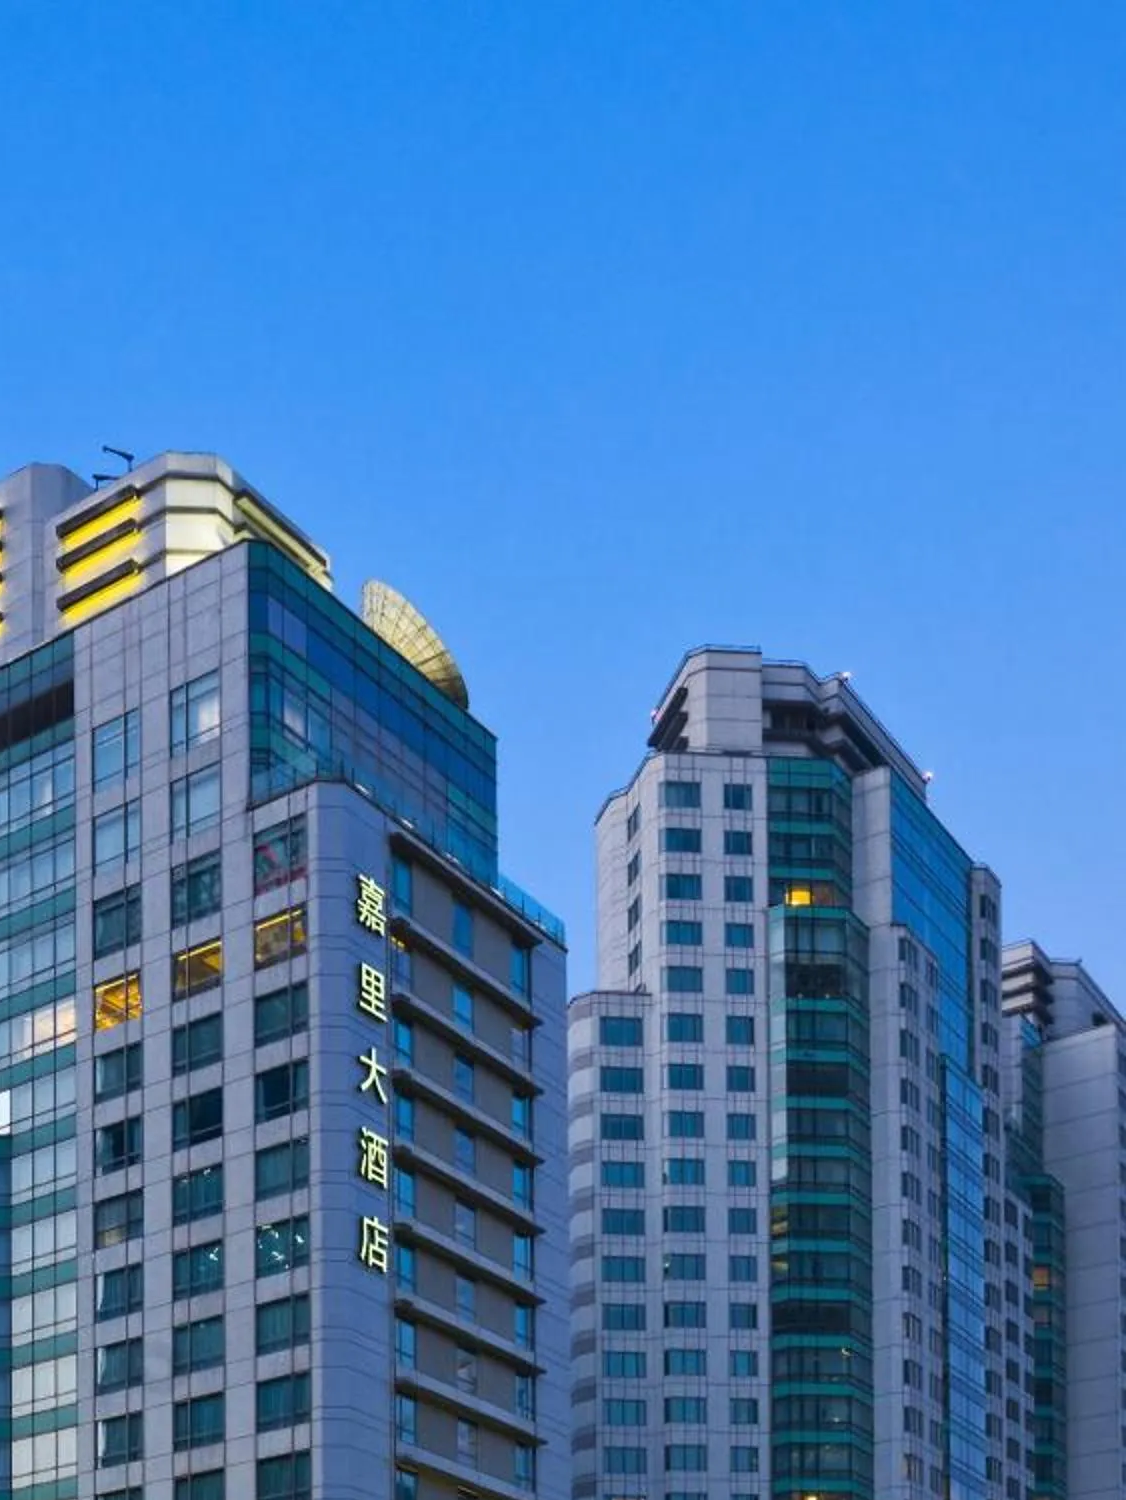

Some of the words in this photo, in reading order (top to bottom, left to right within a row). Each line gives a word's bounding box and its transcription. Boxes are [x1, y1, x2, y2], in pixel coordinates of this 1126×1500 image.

[356, 873, 390, 1274] 嘉里大酒店
